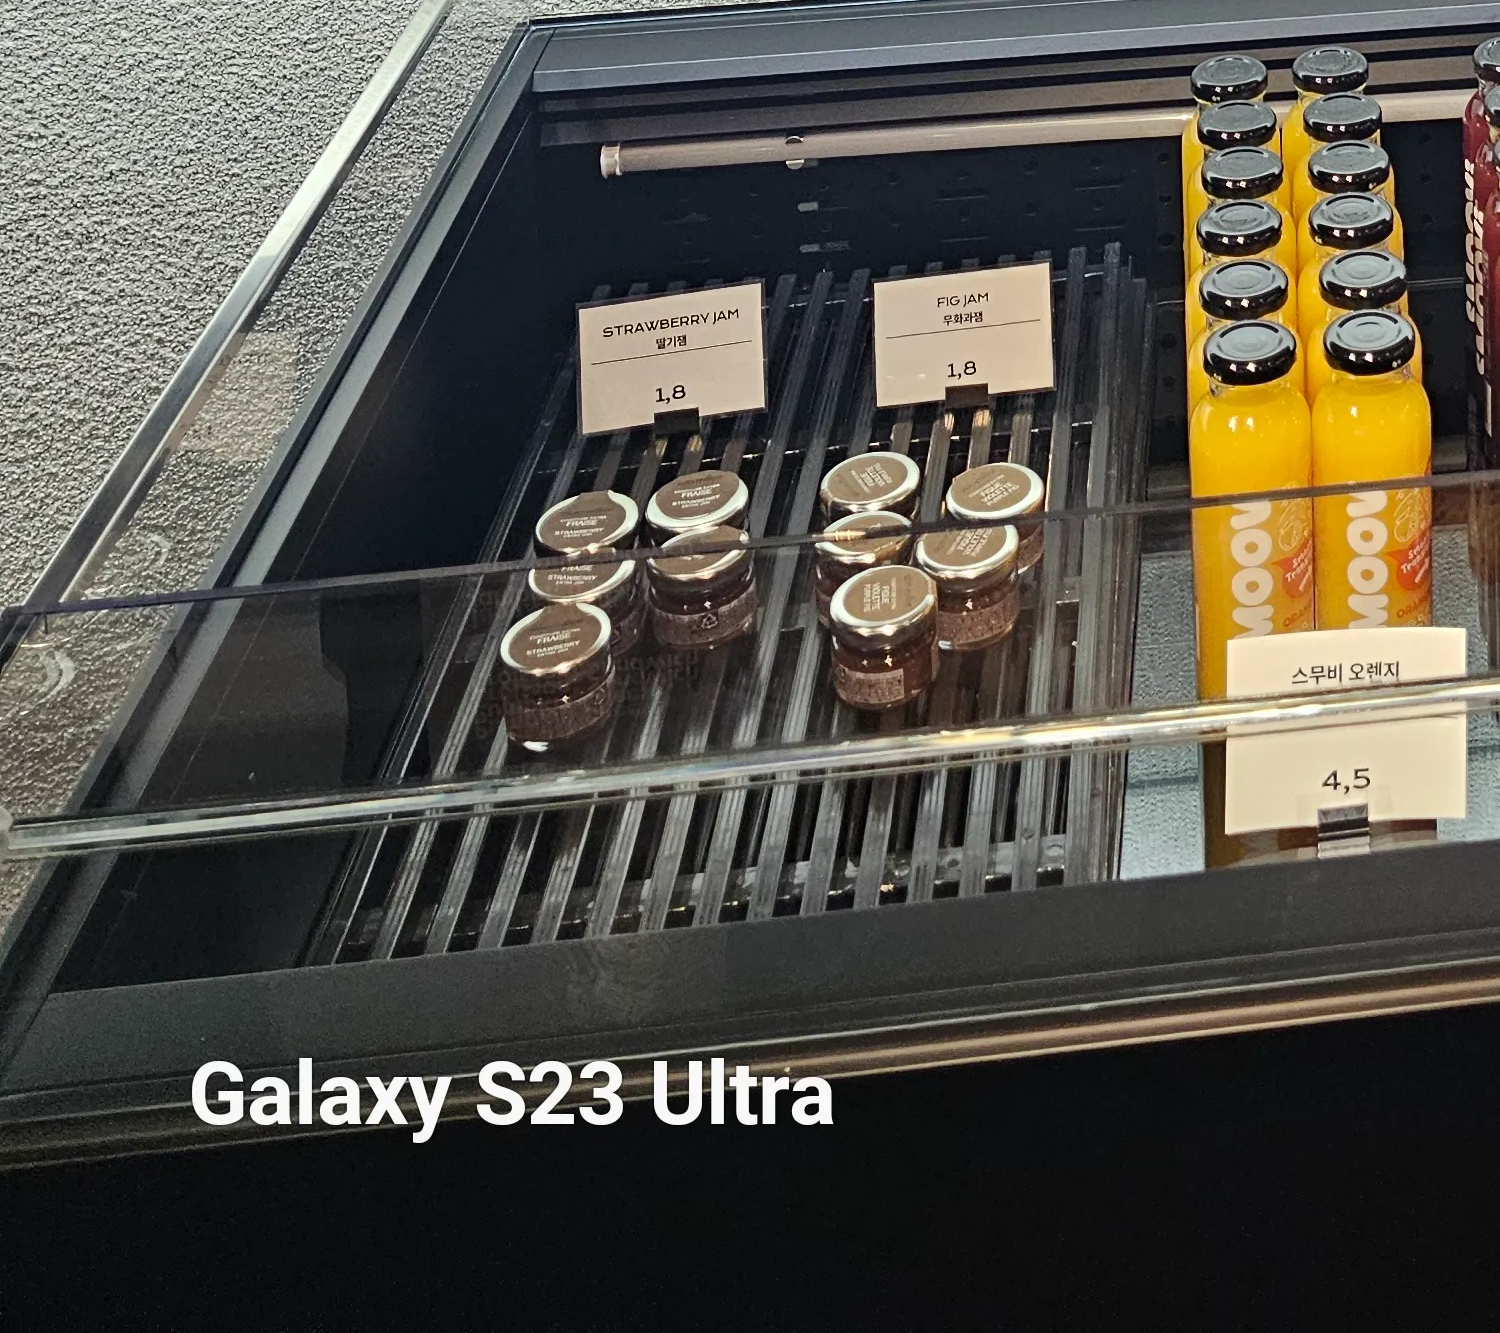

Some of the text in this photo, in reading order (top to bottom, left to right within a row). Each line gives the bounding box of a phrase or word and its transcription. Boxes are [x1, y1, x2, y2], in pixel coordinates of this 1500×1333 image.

[937, 292, 989, 308] FIG JAM
[602, 308, 739, 338] STRAWBERRY JAM
[943, 311, 983, 326] 무화과잼
[656, 334, 687, 350] 딸기잼
[947, 360, 977, 381] 1,8
[654, 384, 687, 404] 1,8
[1291, 660, 1400, 685] 스무비 오렌지
[1321, 767, 1371, 795] 4,5
